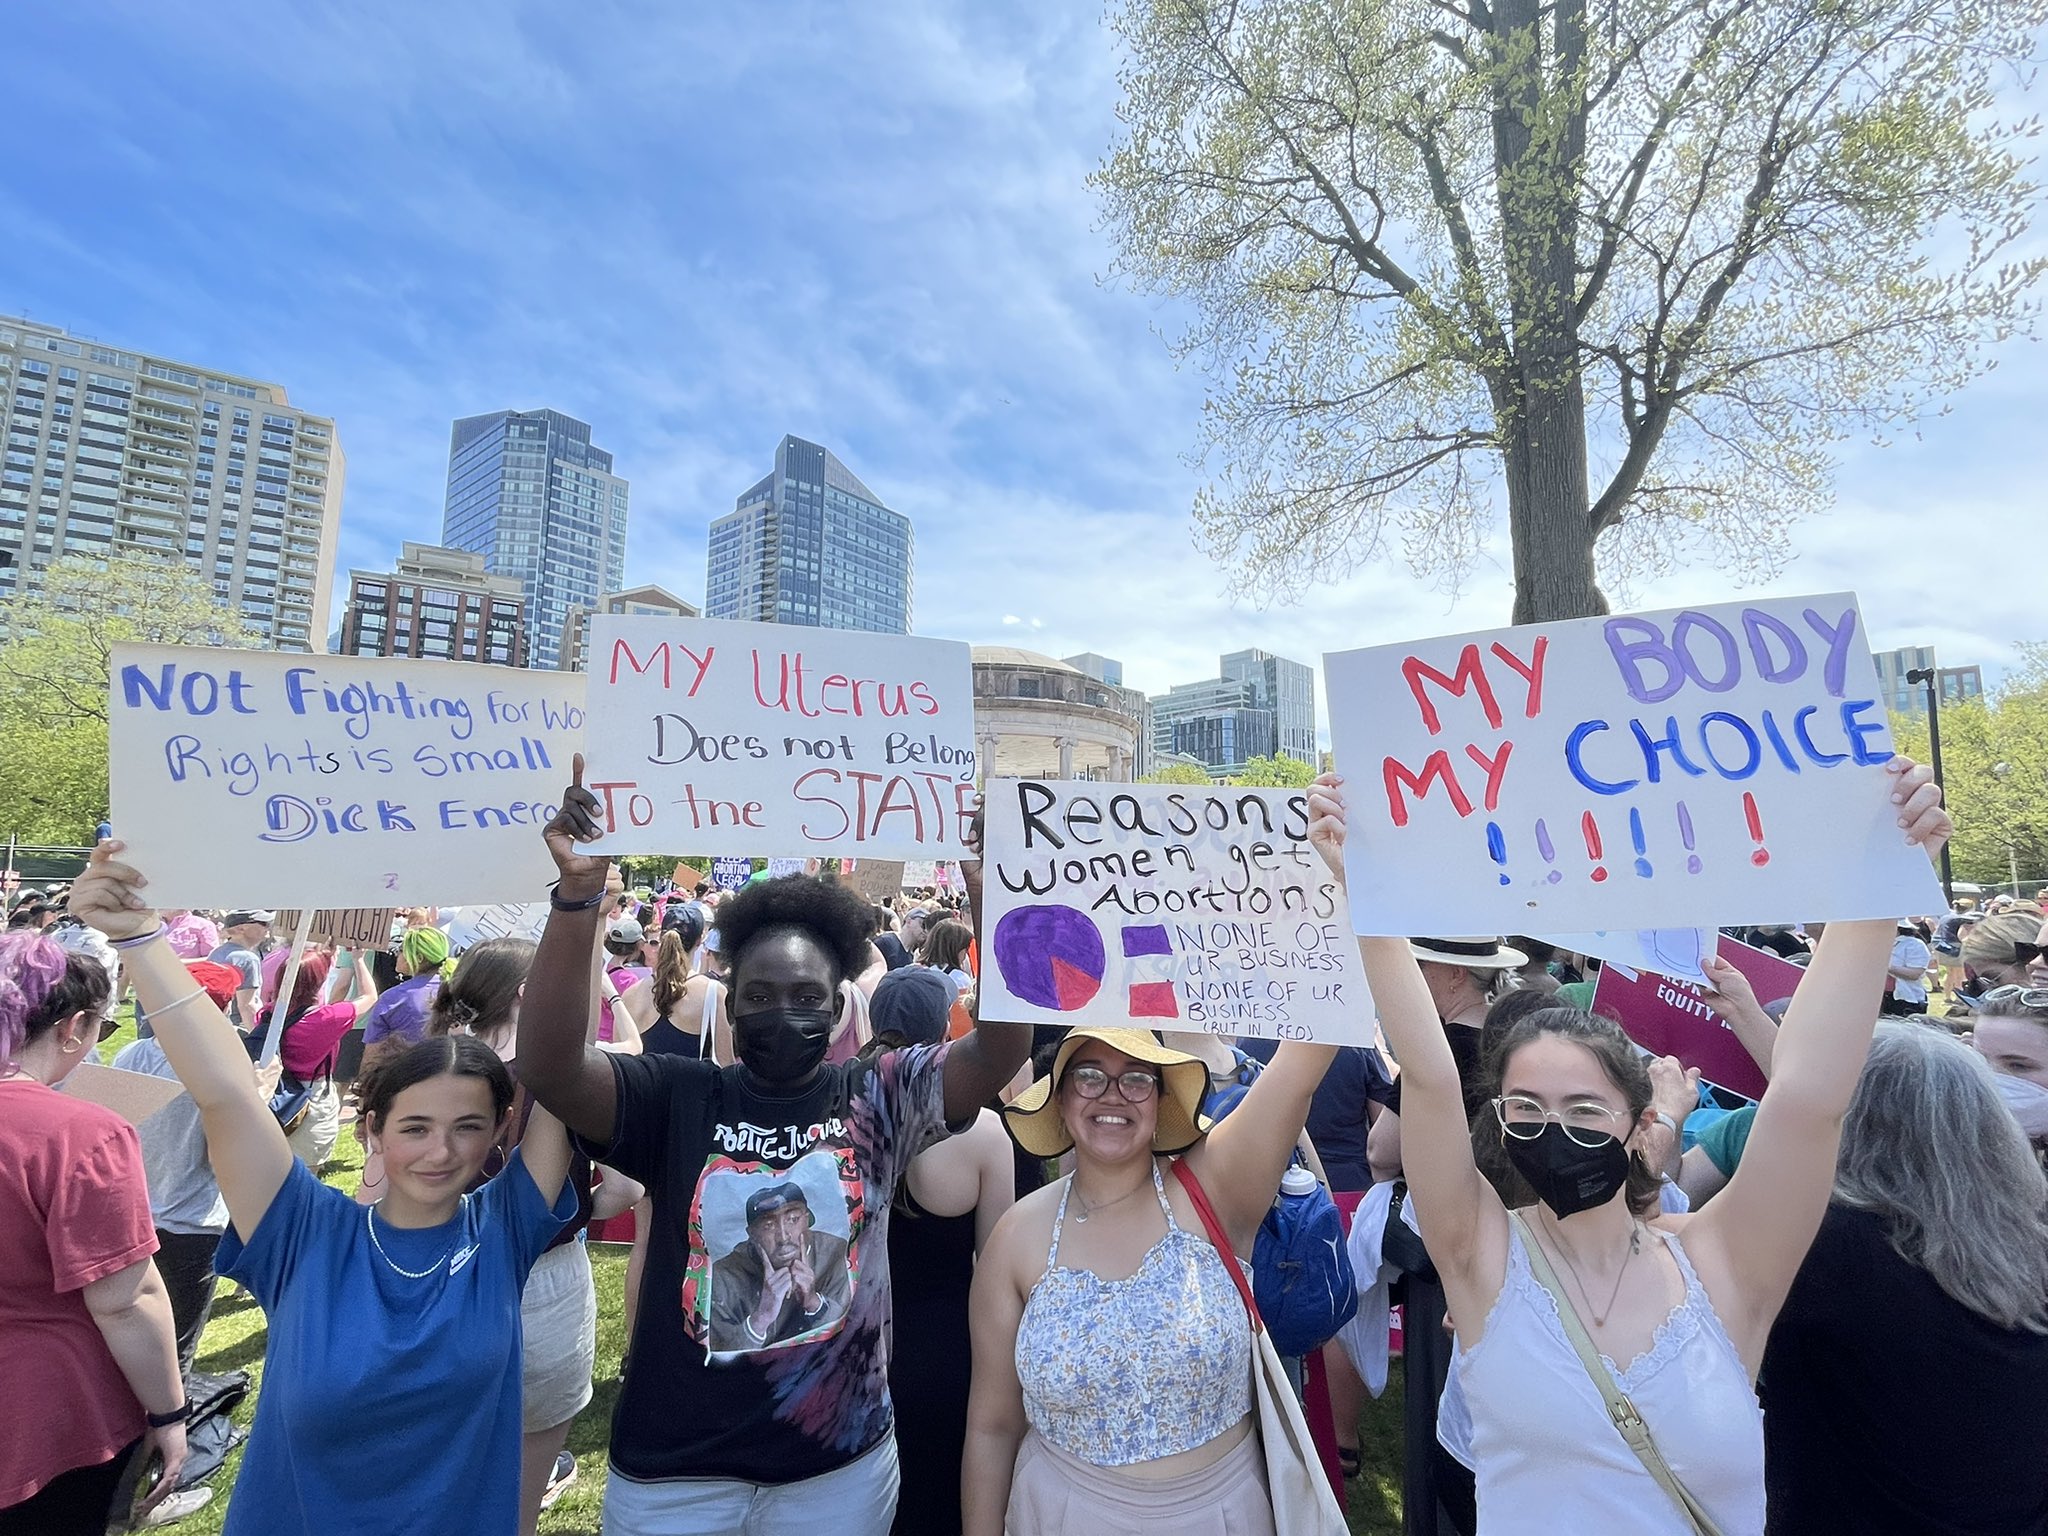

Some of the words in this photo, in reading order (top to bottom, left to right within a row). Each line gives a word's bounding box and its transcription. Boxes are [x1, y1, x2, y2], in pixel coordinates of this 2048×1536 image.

[609, 637, 715, 697] MY
[751, 648, 940, 717] Uterus
[1400, 636, 1548, 735] MY
[1603, 607, 1858, 704] BODY
[285, 668, 472, 740] Fighting
[541, 698, 586, 731] Wo
[165, 735, 340, 795] Rights
[347, 744, 393, 774] is
[647, 713, 769, 765] Does
[784, 734, 856, 761] not
[885, 731, 976, 780] Belong
[1382, 740, 1515, 827] MY
[1564, 699, 1897, 796] CHOICE
[258, 794, 416, 843] Dick
[793, 768, 982, 846] STATE
[1017, 782, 1310, 850] Reasons
[714, 863, 751, 876] ABORTION
[715, 874, 748, 886] LEGAL
[1222, 841, 1312, 895] get
[1091, 879, 1336, 919] Abortions
[1175, 922, 1274, 954] NONE
[1295, 922, 1342, 952] OF
[1185, 950, 1219, 976] UR
[1239, 949, 1345, 973] BUSINESS
[1184, 980, 1255, 1001] NONE
[1266, 980, 1298, 1002] OF
[1312, 983, 1345, 1005] UR
[1187, 1001, 1291, 1022] BUSINESS
[1657, 983, 1715, 1021] EQUITY
[1248, 1023, 1262, 1037] IN
